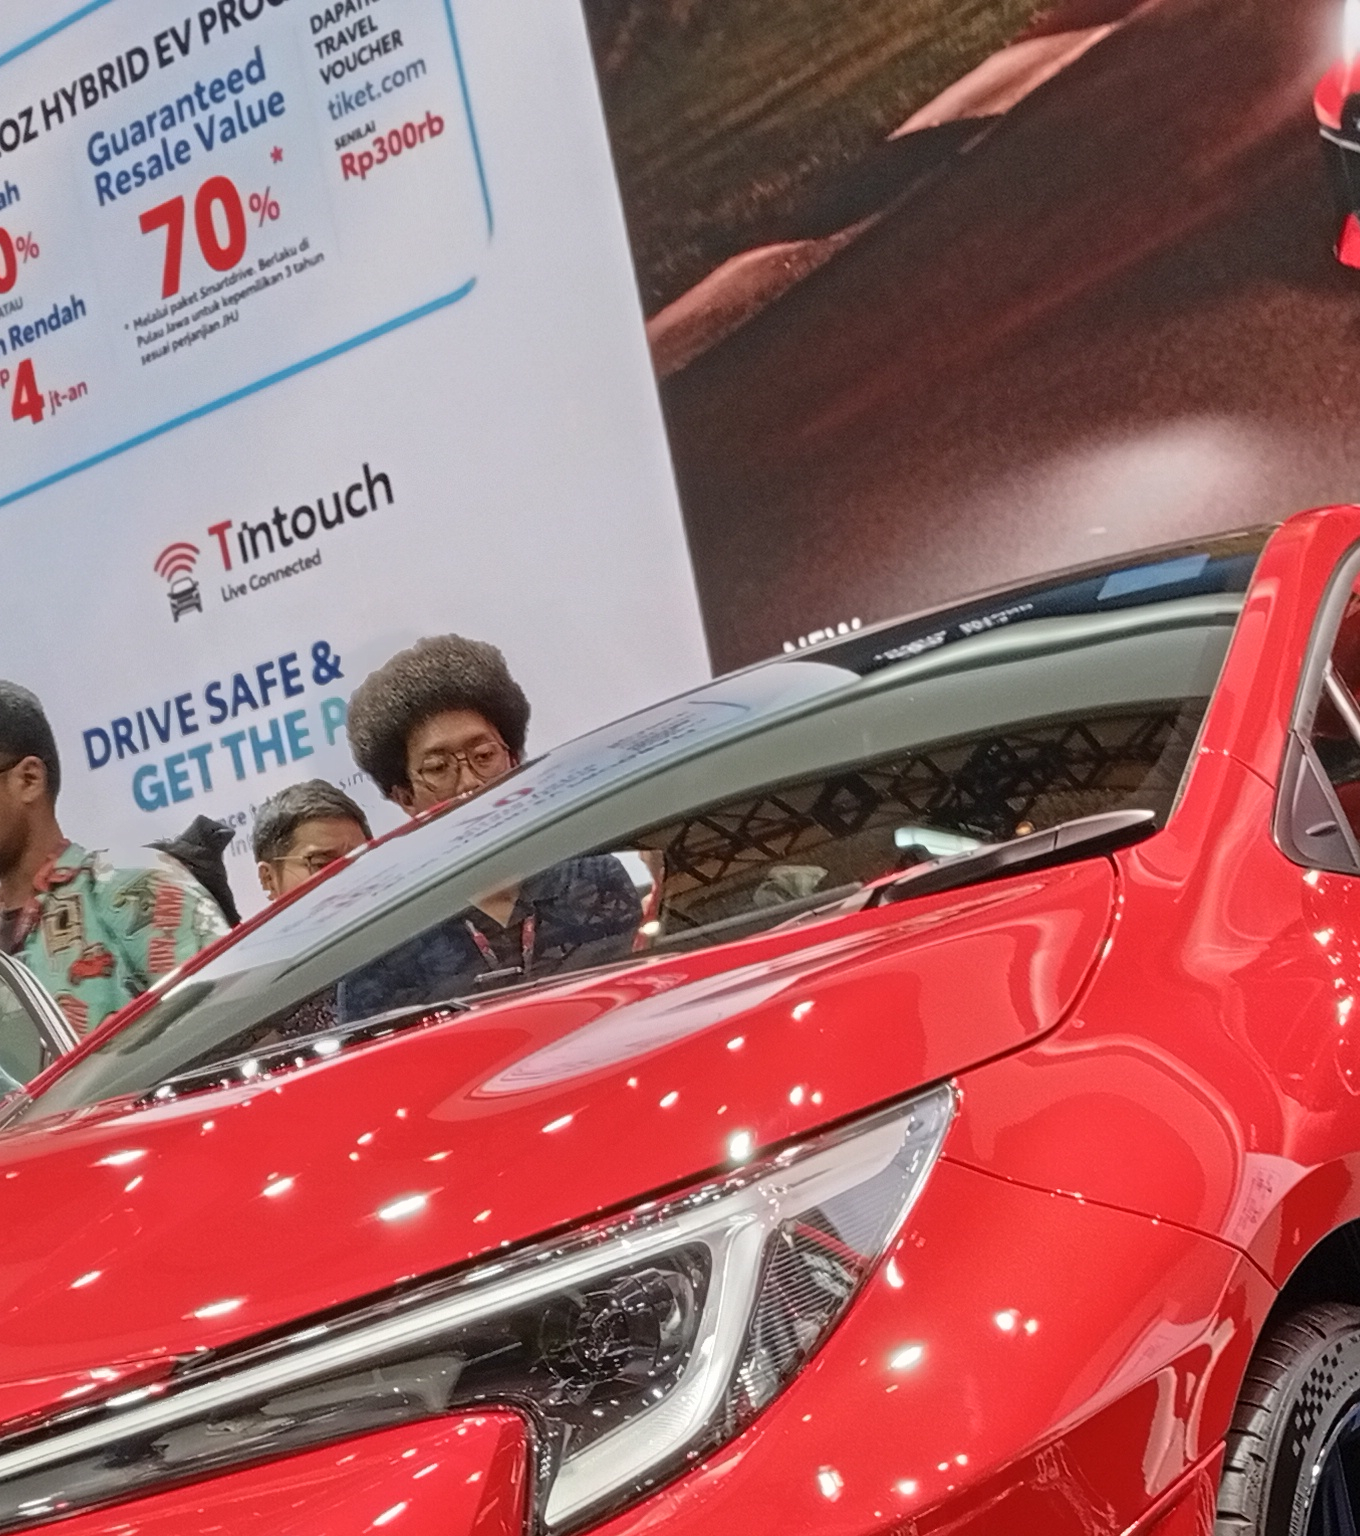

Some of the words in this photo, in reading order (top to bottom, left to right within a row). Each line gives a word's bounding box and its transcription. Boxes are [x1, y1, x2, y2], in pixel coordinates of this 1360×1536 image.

[40, 46, 150, 131] HYBRID
[154, 18, 191, 69] EV
[198, 0, 288, 45] PRO
[315, 15, 379, 60] TRAVEL
[319, 29, 405, 85] VOUCHER
[87, 45, 267, 166] Guaranteed
[327, 58, 428, 121] tiket.com
[95, 137, 192, 206] Resale
[193, 91, 286, 152] Value
[339, 110, 446, 181] Rp300rb
[8, 294, 87, 351] Rendah
[133, 304, 169, 331] Melalui
[170, 291, 199, 317] paket
[258, 244, 298, 272] Berlaku
[299, 237, 310, 252] di
[166, 315, 191, 336] Jawa
[191, 300, 220, 322] untuk
[221, 270, 285, 308] kepemilikan
[293, 251, 325, 274] tahun
[11, 357, 45, 425] 4
[48, 381, 89, 416] jt-an
[220, 576, 248, 603] Live
[249, 548, 323, 593] Connected
[83, 692, 200, 771] DRIVE
[204, 652, 306, 726] SAFE
[311, 640, 345, 686] &
[132, 742, 215, 814] GET
[219, 709, 317, 781] THE
